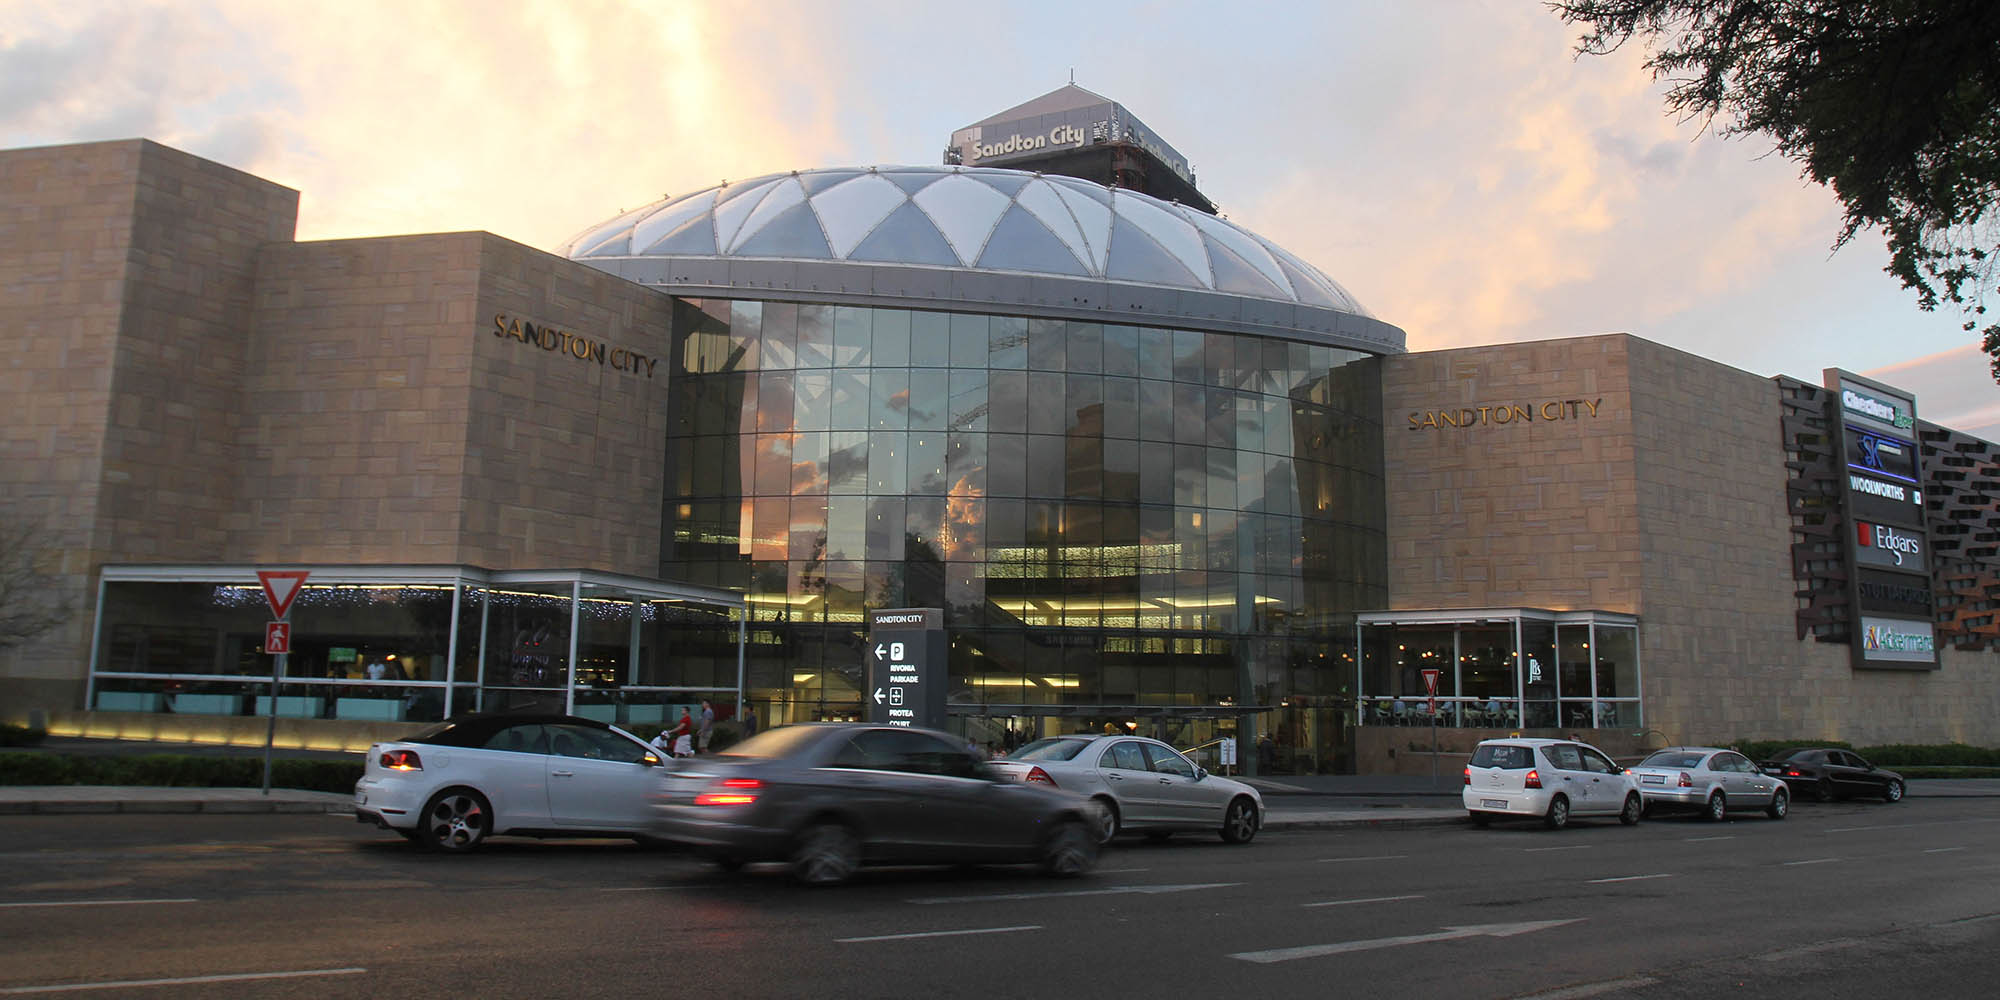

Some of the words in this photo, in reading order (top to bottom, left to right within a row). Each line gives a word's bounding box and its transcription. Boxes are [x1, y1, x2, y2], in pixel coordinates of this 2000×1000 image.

[972, 134, 1046, 160] Sandton
[1050, 125, 1085, 148] City
[494, 313, 606, 366] SANDTON
[610, 348, 657, 378] CITY
[1408, 403, 1533, 431] SANDTON
[1540, 398, 1602, 421] CITY
[1850, 475, 1905, 501] WOOLWORTHS
[1875, 525, 1920, 566] Edgars
[875, 615, 907, 624] SANDTON
[907, 614, 923, 623] CITY
[890, 664, 916, 672] RIVONIA
[889, 709, 914, 717] PROTEA
